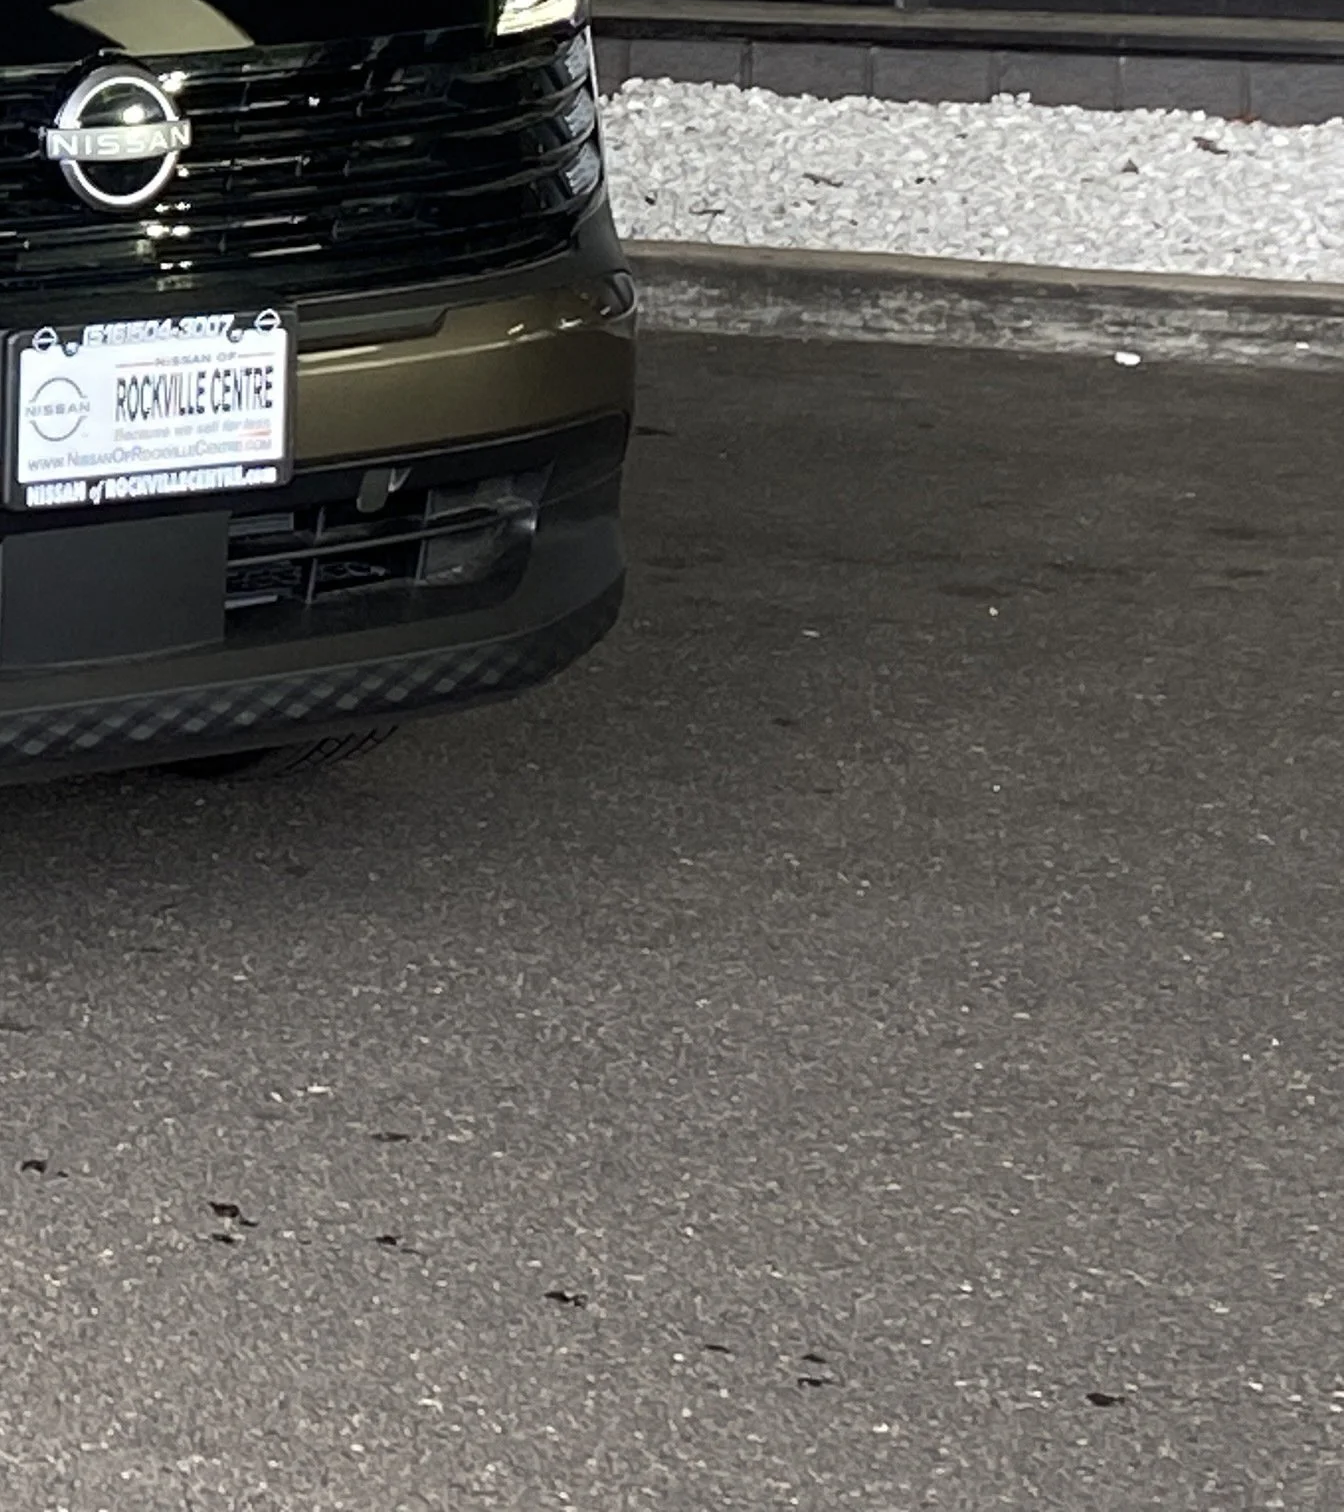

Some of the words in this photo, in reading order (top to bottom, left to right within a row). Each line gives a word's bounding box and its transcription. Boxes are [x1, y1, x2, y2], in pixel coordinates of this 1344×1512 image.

[50, 123, 190, 157] NISSAN
[115, 370, 207, 423] ROCKVILLE
[210, 365, 275, 415] CENTRE
[25, 401, 91, 418] NISSAN
[26, 480, 87, 507] NISSAN
